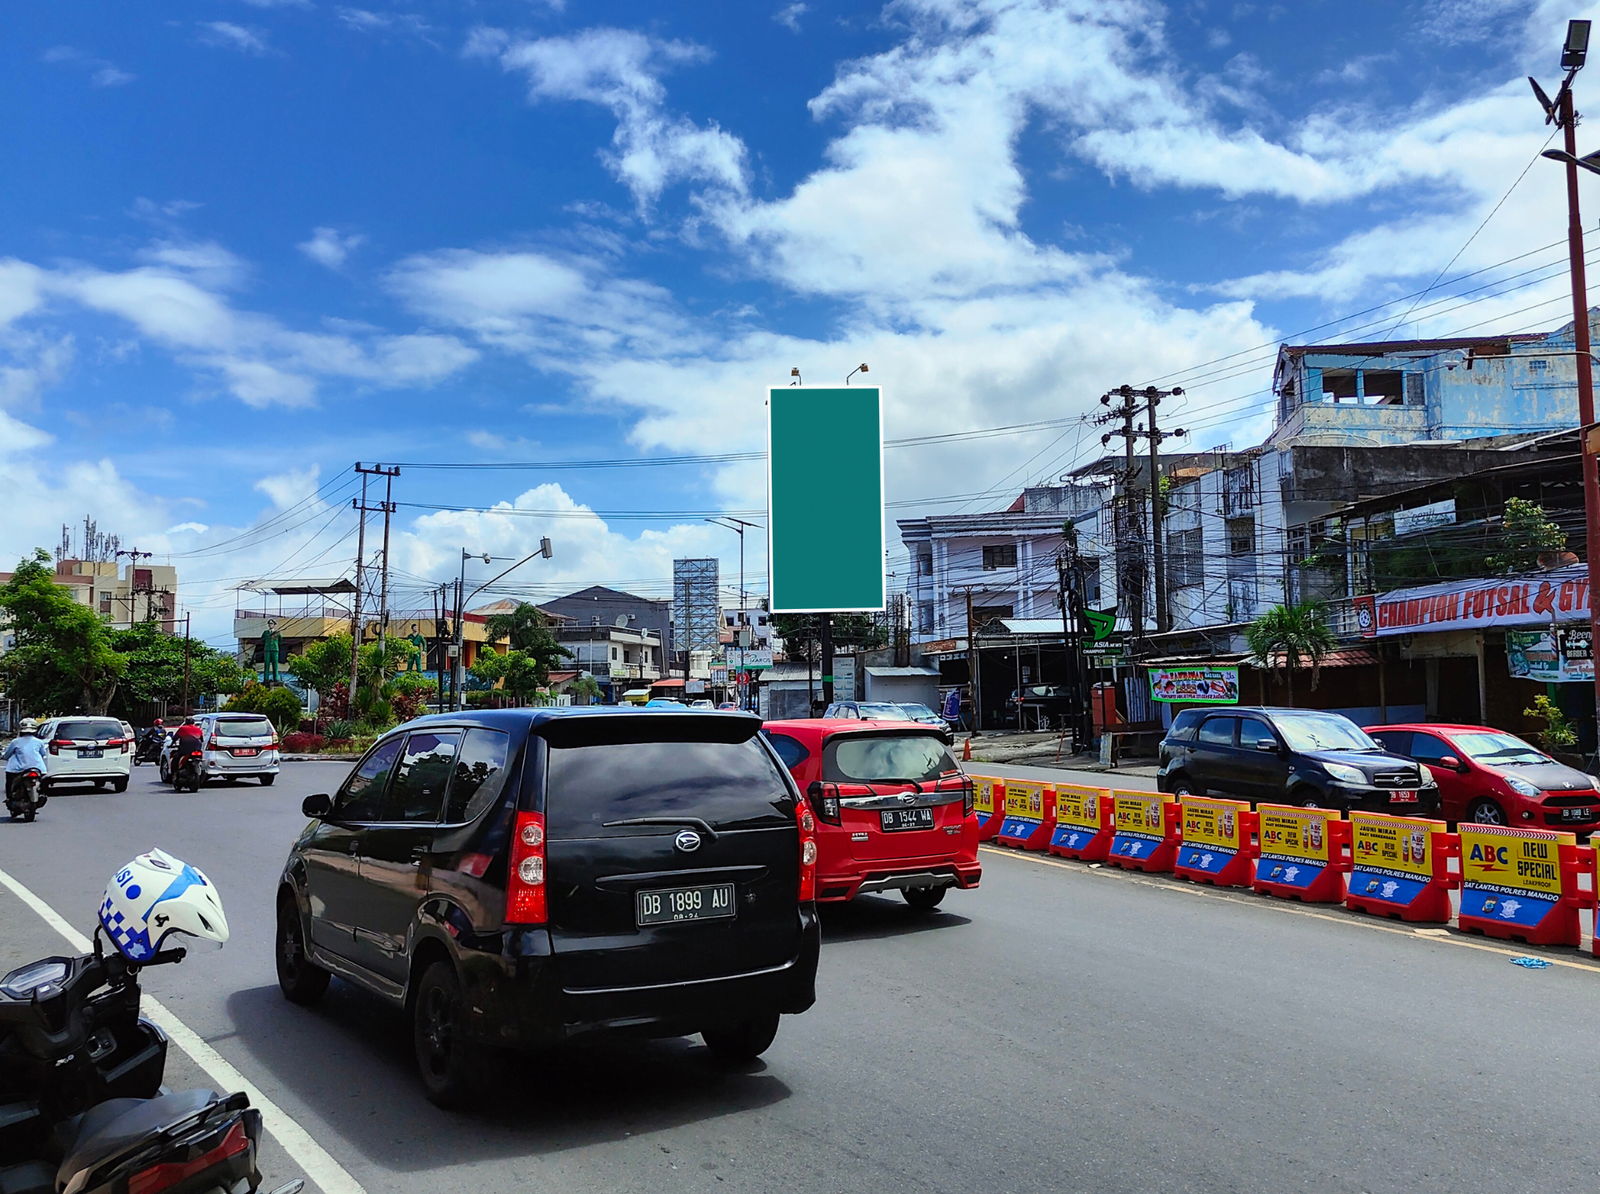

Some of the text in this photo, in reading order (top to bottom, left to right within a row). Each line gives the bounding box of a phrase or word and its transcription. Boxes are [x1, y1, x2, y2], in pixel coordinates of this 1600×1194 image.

[1379, 594, 1458, 628] CHAMPION
[1463, 584, 1530, 619] FUTSAL
[1559, 580, 1592, 612] GY
[1059, 804, 1070, 812] ABC
[884, 810, 931, 824] DB 1544 WA
[1118, 812, 1130, 820] ABC
[1186, 820, 1200, 829] ABC
[1264, 830, 1282, 841] ABC
[1357, 840, 1378, 852] ABC
[1523, 842, 1548, 859] NEW
[1382, 850, 1397, 858] SPECIAL
[1470, 844, 1508, 865] ABC
[1304, 859, 1328, 867] MANADO
[1383, 869, 1404, 878] POLRES
[1405, 872, 1431, 882] MANADO
[1518, 861, 1557, 880] SPECIAL
[1523, 880, 1551, 888] LEAKPROOF
[1475, 883, 1499, 892] LANTAS
[1500, 887, 1526, 896] POLRES
[1527, 890, 1559, 901] MANADO
[643, 888, 728, 915] DB 1899 AU
